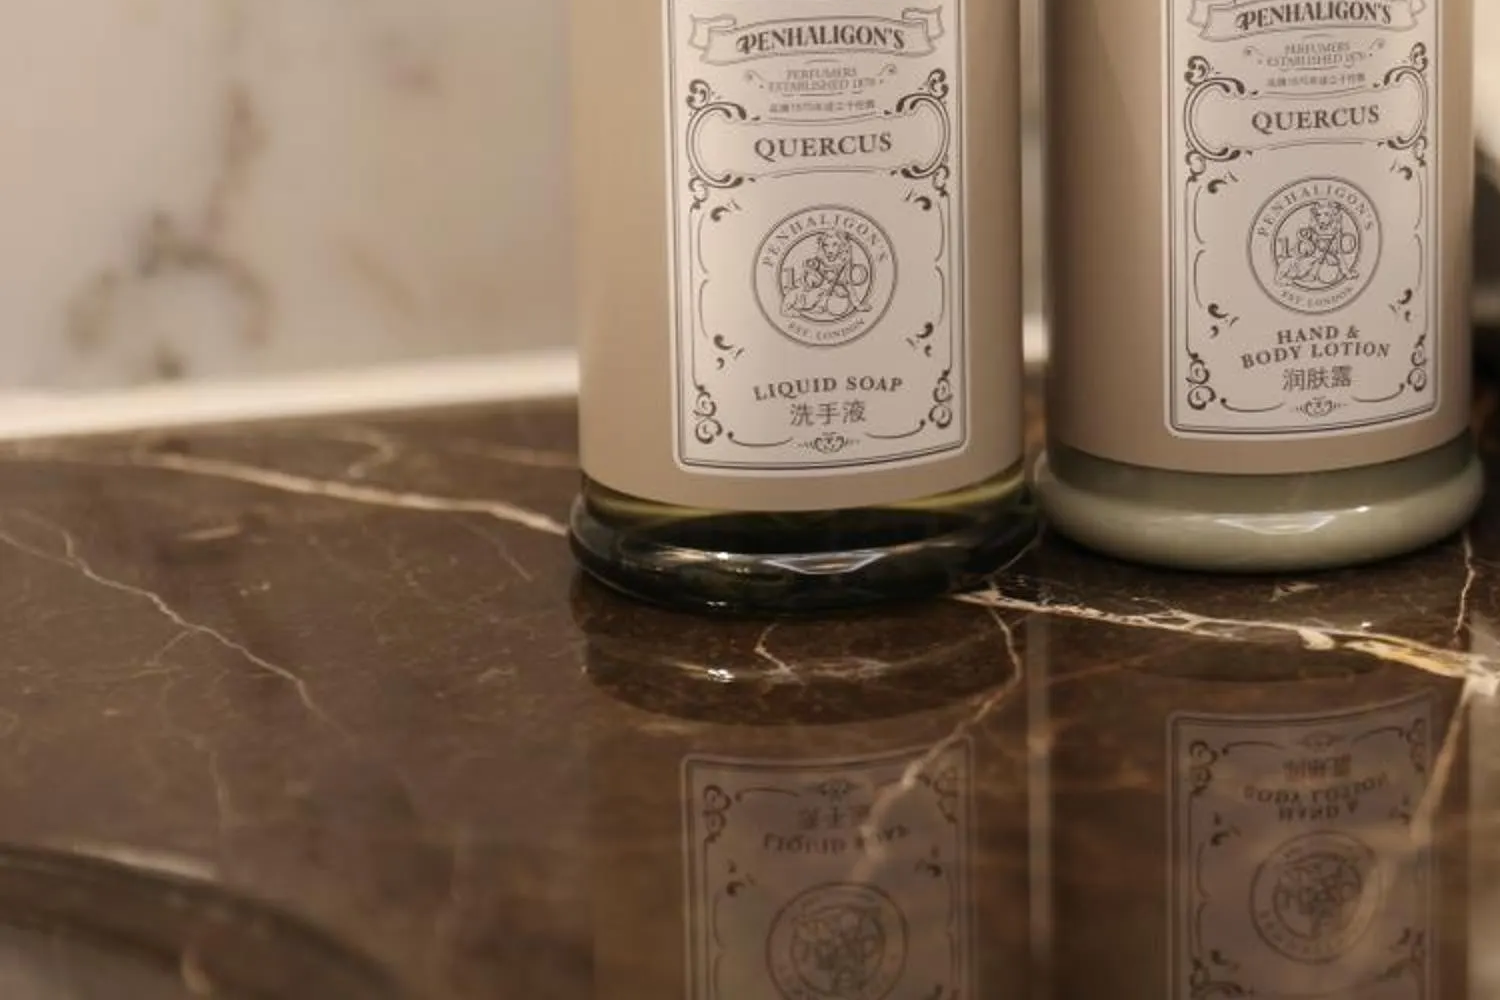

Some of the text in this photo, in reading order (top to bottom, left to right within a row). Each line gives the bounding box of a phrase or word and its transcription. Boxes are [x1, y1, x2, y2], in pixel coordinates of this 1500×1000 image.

[1235, 0, 1392, 31] PENHALIGON'S
[735, 23, 906, 54] PENHALIGON'S
[1251, 104, 1380, 135] QUERCUS
[754, 132, 893, 163] QUERCUS
[1276, 325, 1360, 345] HAND &
[1240, 340, 1392, 370] BODY LOTION
[752, 375, 905, 401] LIQUID SOAP
[1281, 365, 1353, 391] 润肤露
[789, 400, 867, 427] 洗手液
